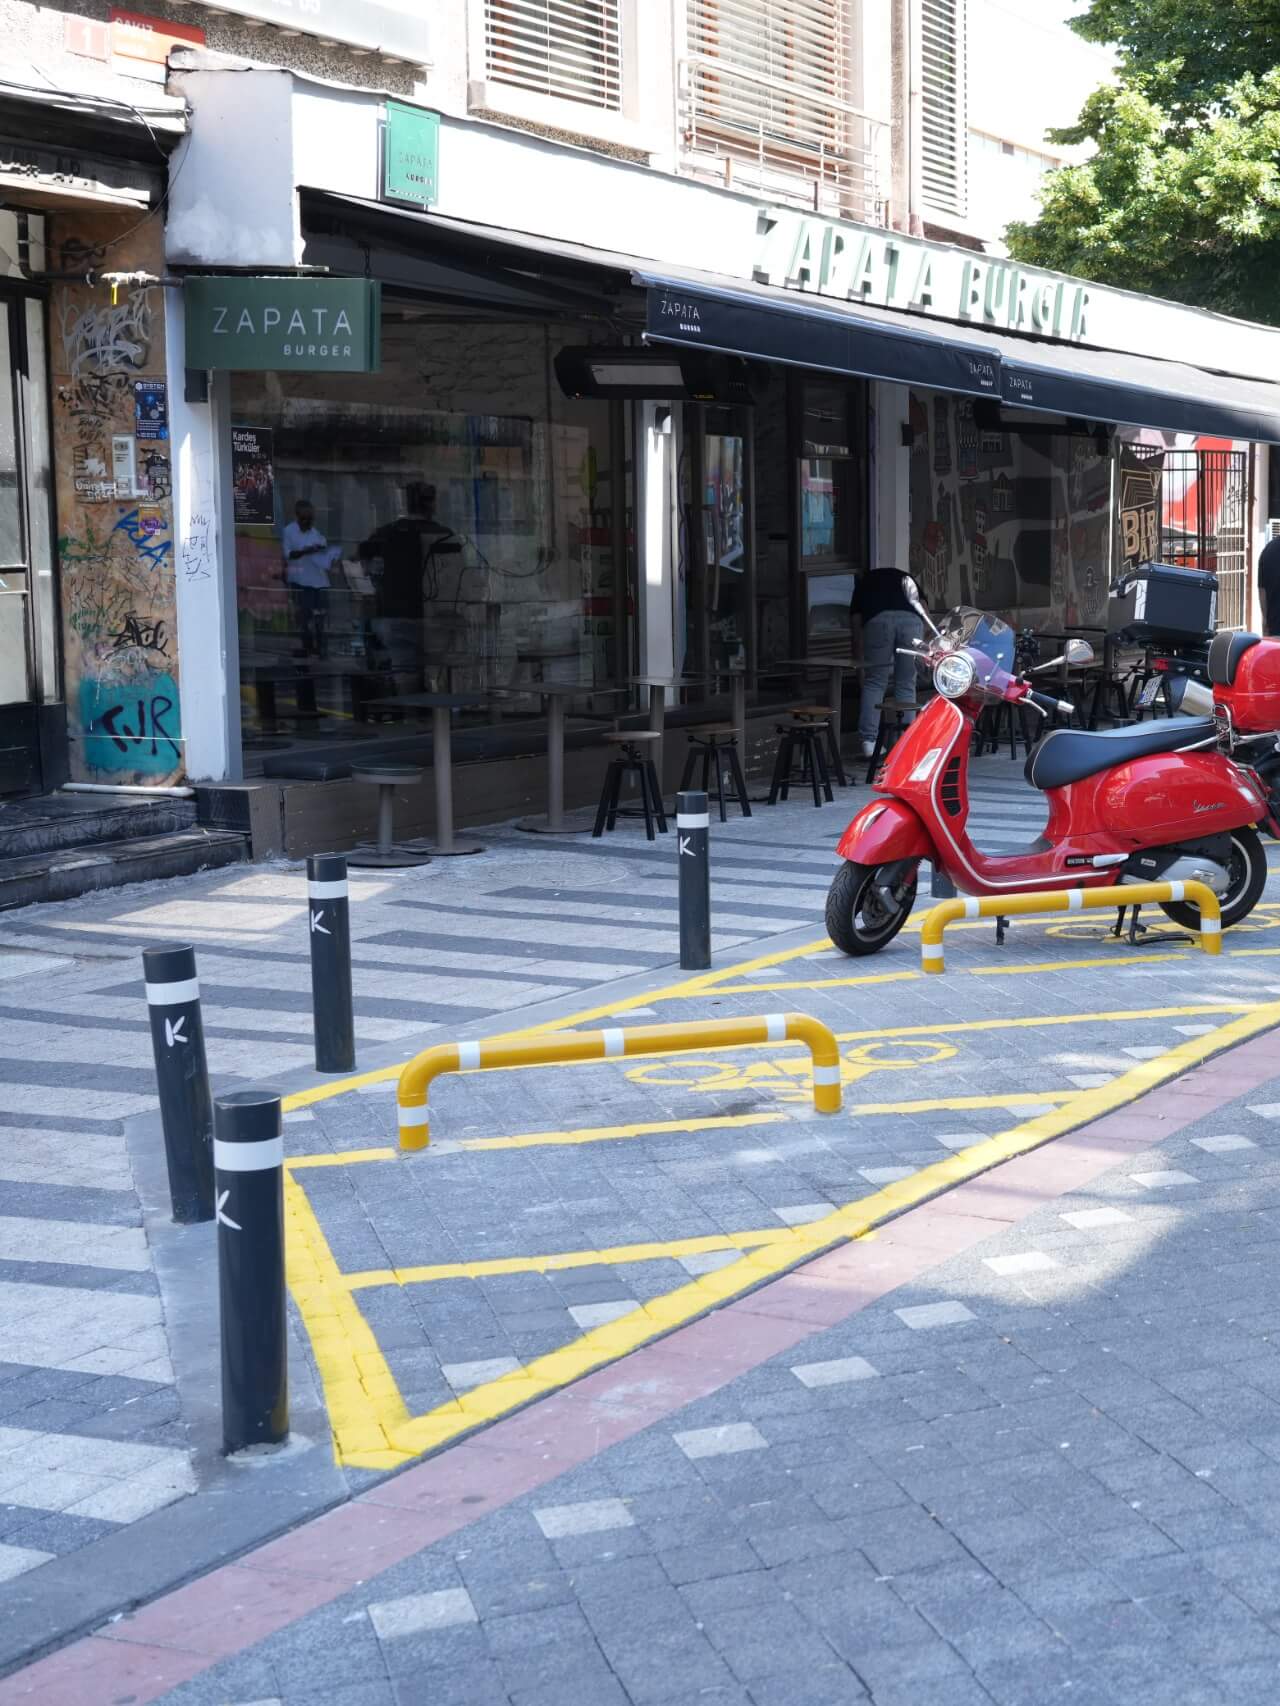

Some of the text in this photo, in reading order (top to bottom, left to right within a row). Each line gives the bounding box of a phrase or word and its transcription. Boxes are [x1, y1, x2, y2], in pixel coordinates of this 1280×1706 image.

[750, 208, 934, 313] ZAPATA
[660, 300, 700, 320] ZAPATA
[212, 307, 353, 336] ZAPATA
[283, 344, 352, 357] BURGER
[233, 431, 257, 444] Kardeş
[233, 441, 261, 453] Türküler
